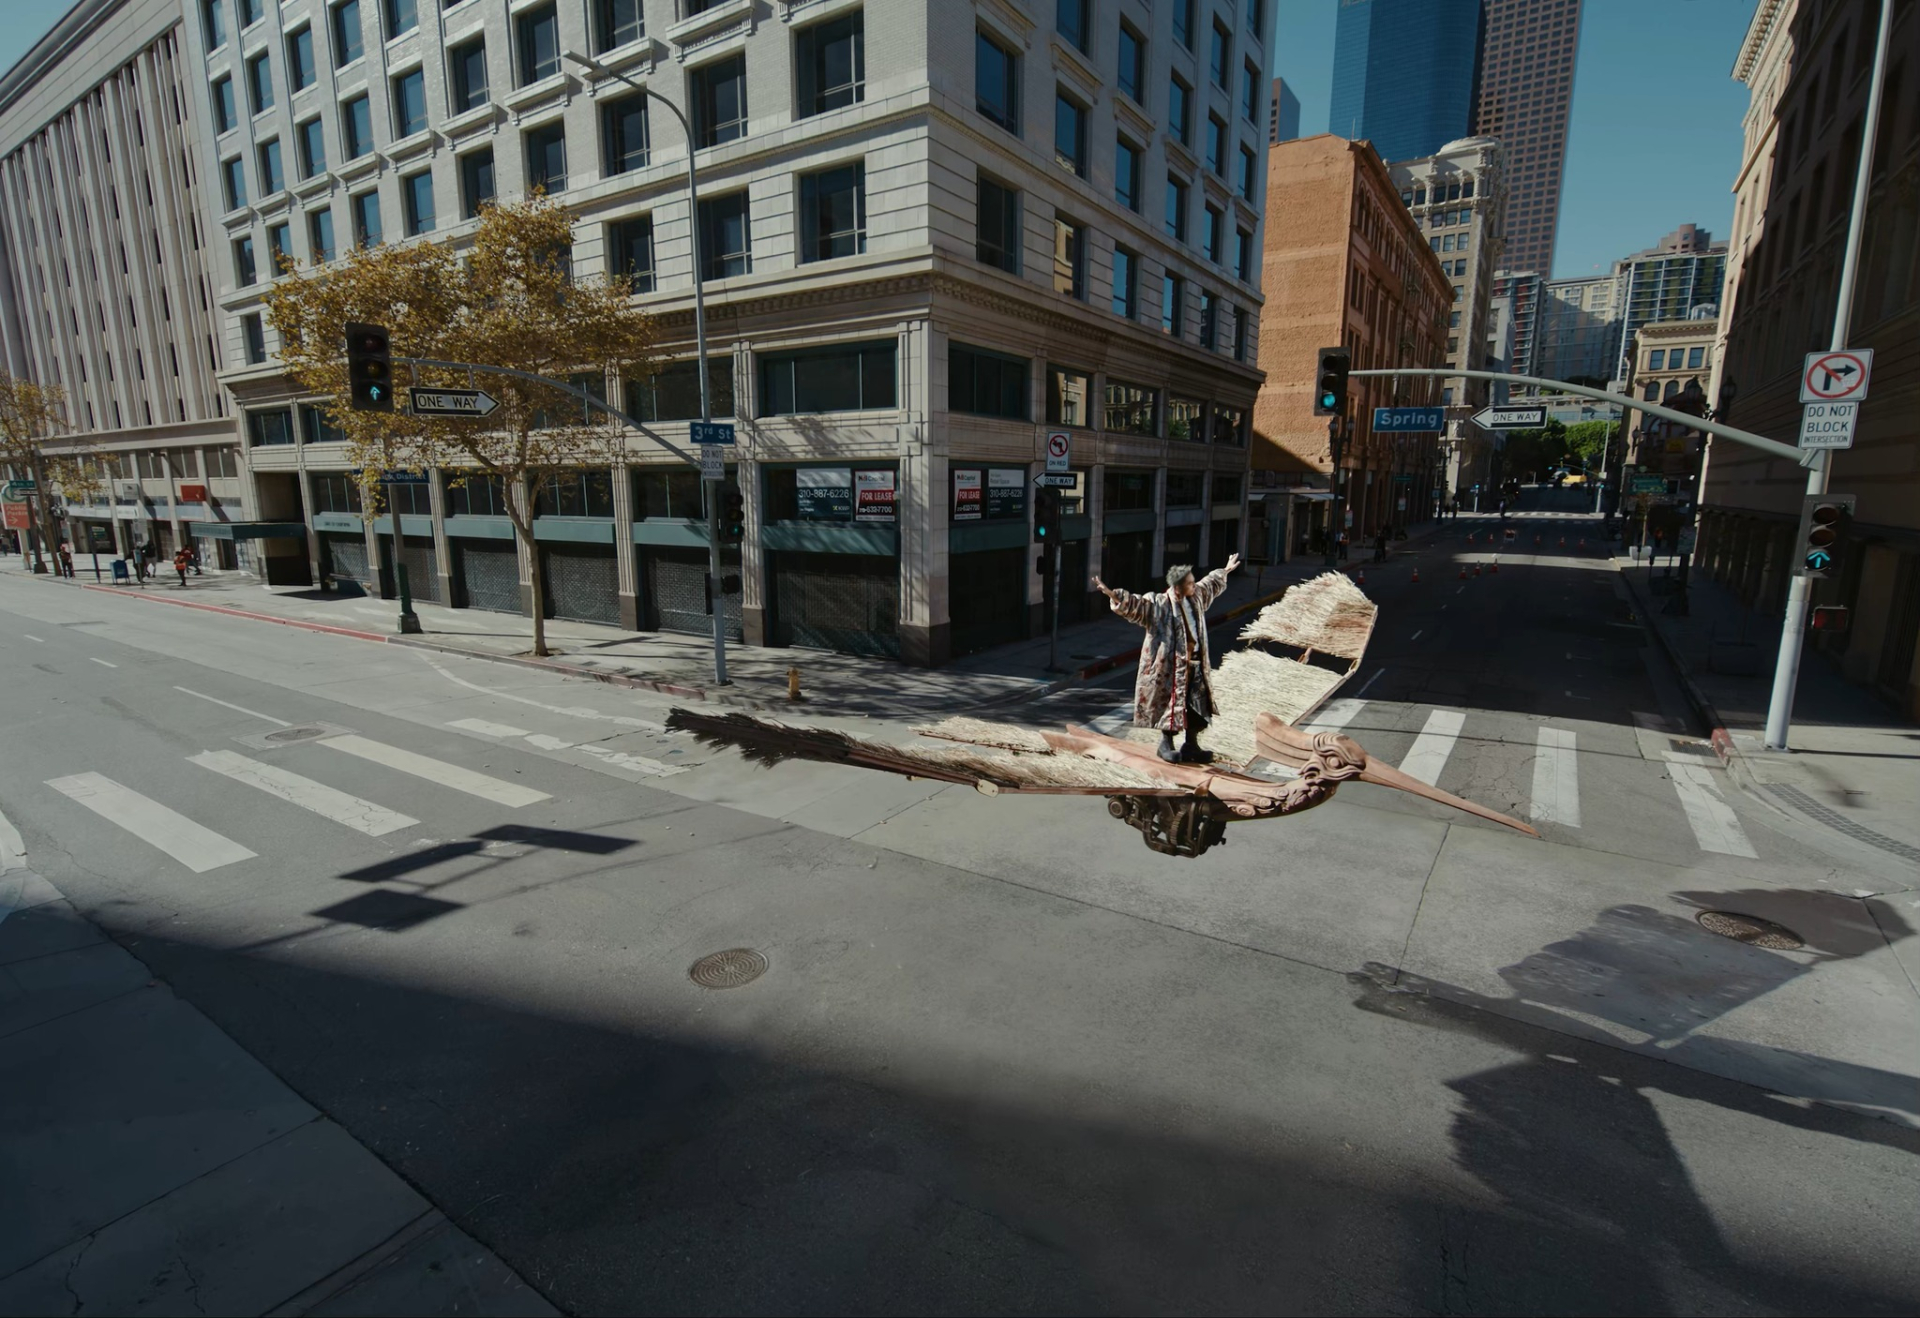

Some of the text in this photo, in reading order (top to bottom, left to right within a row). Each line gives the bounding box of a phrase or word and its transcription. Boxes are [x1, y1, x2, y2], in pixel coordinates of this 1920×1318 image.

[418, 395, 478, 408] ONE WAY
[1808, 405, 1854, 417] DO NOT
[1380, 412, 1438, 428] Spring
[1492, 413, 1513, 421] ONE
[1806, 421, 1849, 432] BLOCK
[694, 426, 731, 440] 3rd St
[1803, 435, 1849, 443] INTERSECTION
[702, 450, 722, 459] DO NOT
[702, 461, 722, 469] BLOCK
[798, 489, 849, 498] 310-887-6226
[861, 492, 892, 501] FOR LEASE
[959, 491, 980, 499] FOR LEASE
